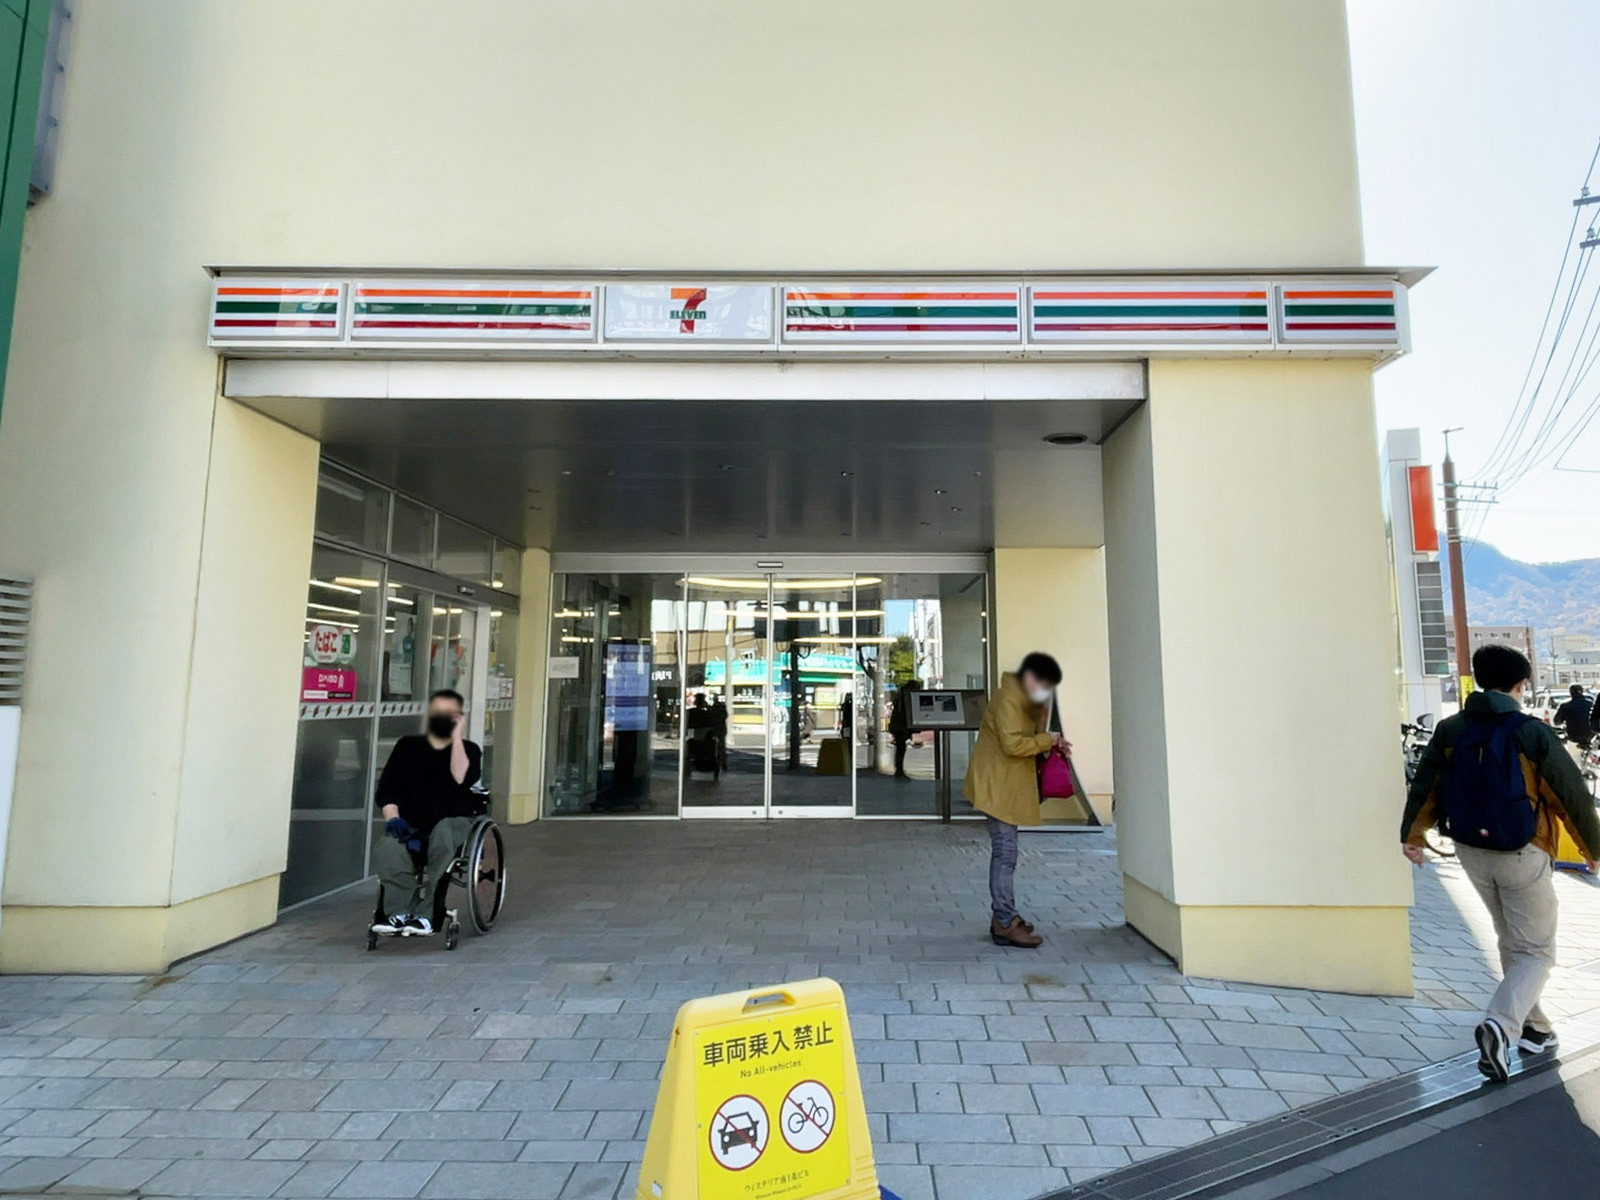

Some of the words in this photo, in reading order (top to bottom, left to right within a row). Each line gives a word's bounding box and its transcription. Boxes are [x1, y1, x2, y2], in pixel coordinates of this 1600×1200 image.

[670, 287, 707, 334] 7
[314, 631, 338, 652] たばこ
[703, 1021, 834, 1067] 車両乗入禁止
[740, 1068, 752, 1078] No
[754, 1059, 802, 1076] All-vehicles
